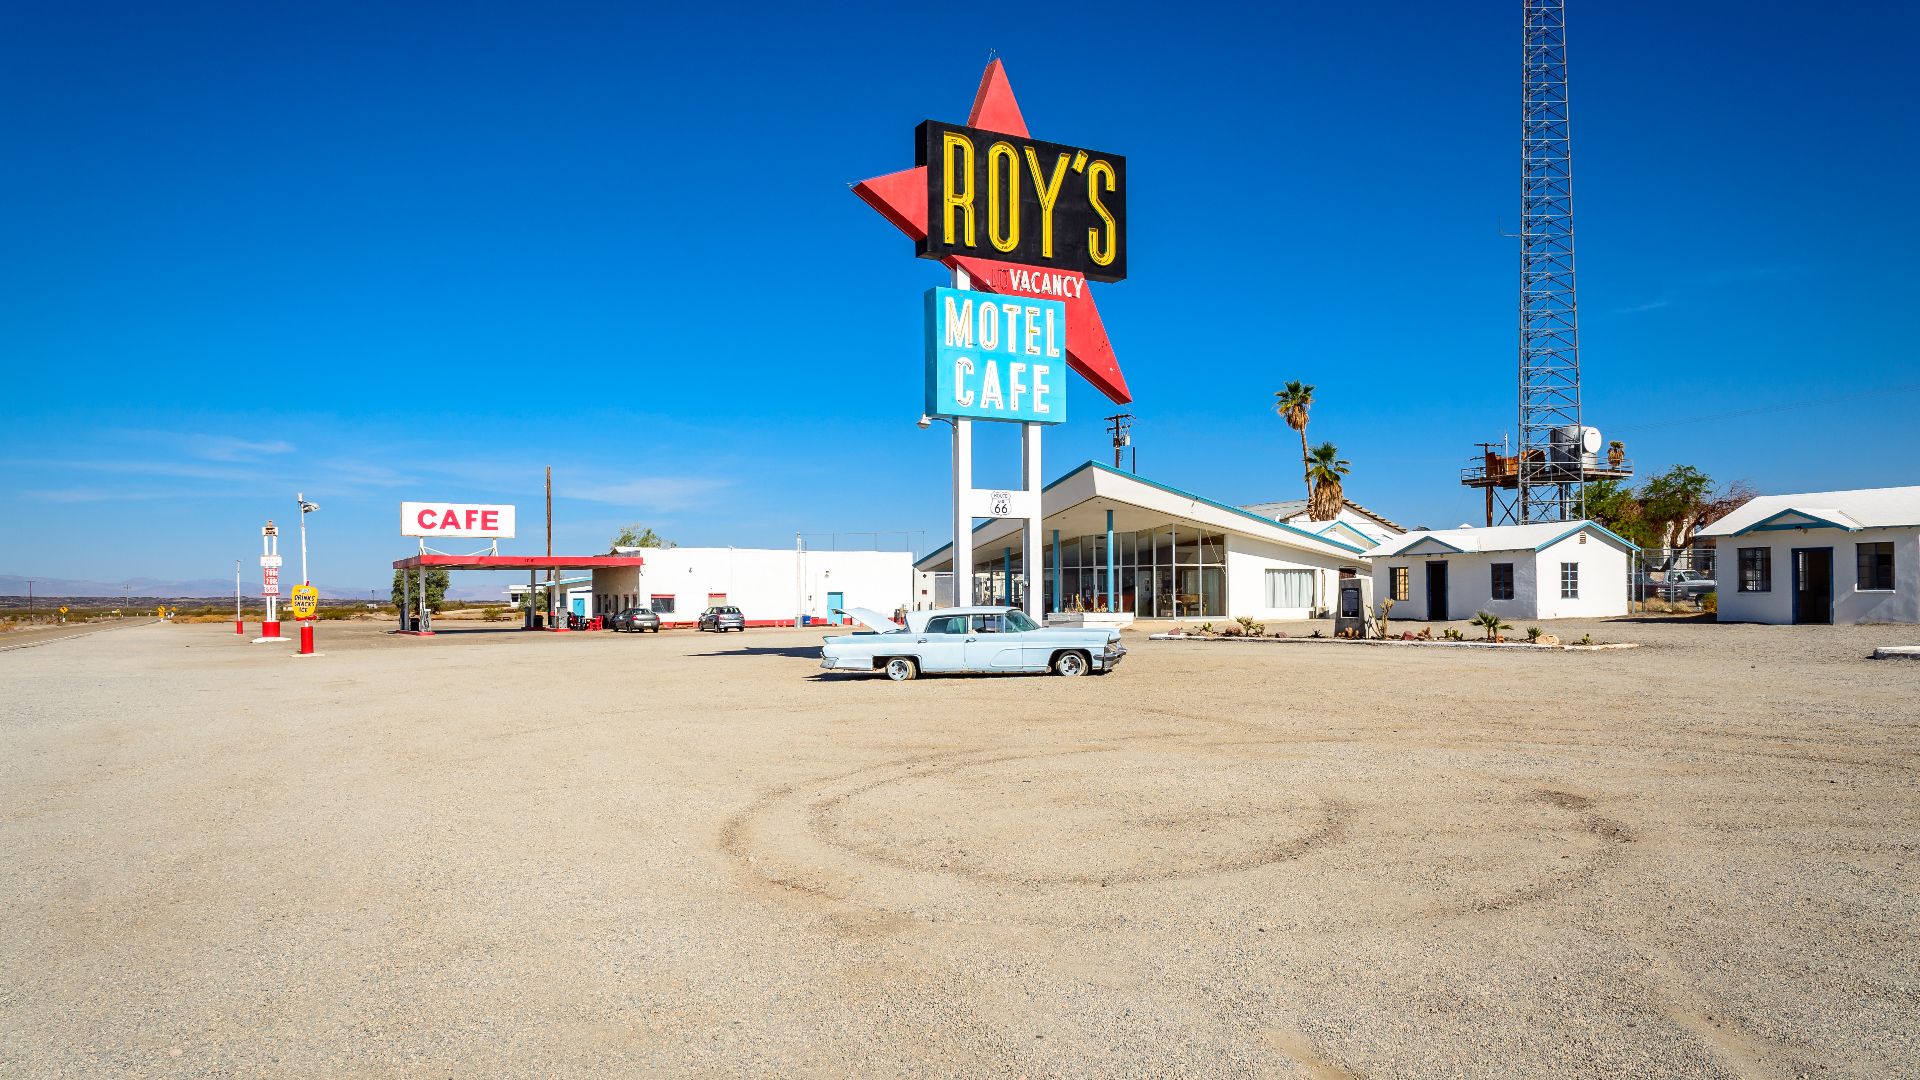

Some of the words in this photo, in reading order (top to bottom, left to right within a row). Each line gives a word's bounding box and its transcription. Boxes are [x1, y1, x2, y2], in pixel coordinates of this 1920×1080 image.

[943, 130, 1117, 267] ROY'S
[1009, 268, 1085, 299] VACANCY
[945, 296, 1060, 358] MOTEL
[955, 356, 1050, 413] CAFE
[417, 508, 499, 531] CAFE
[994, 503, 1008, 514] 66
[294, 594, 316, 602] DRINKS
